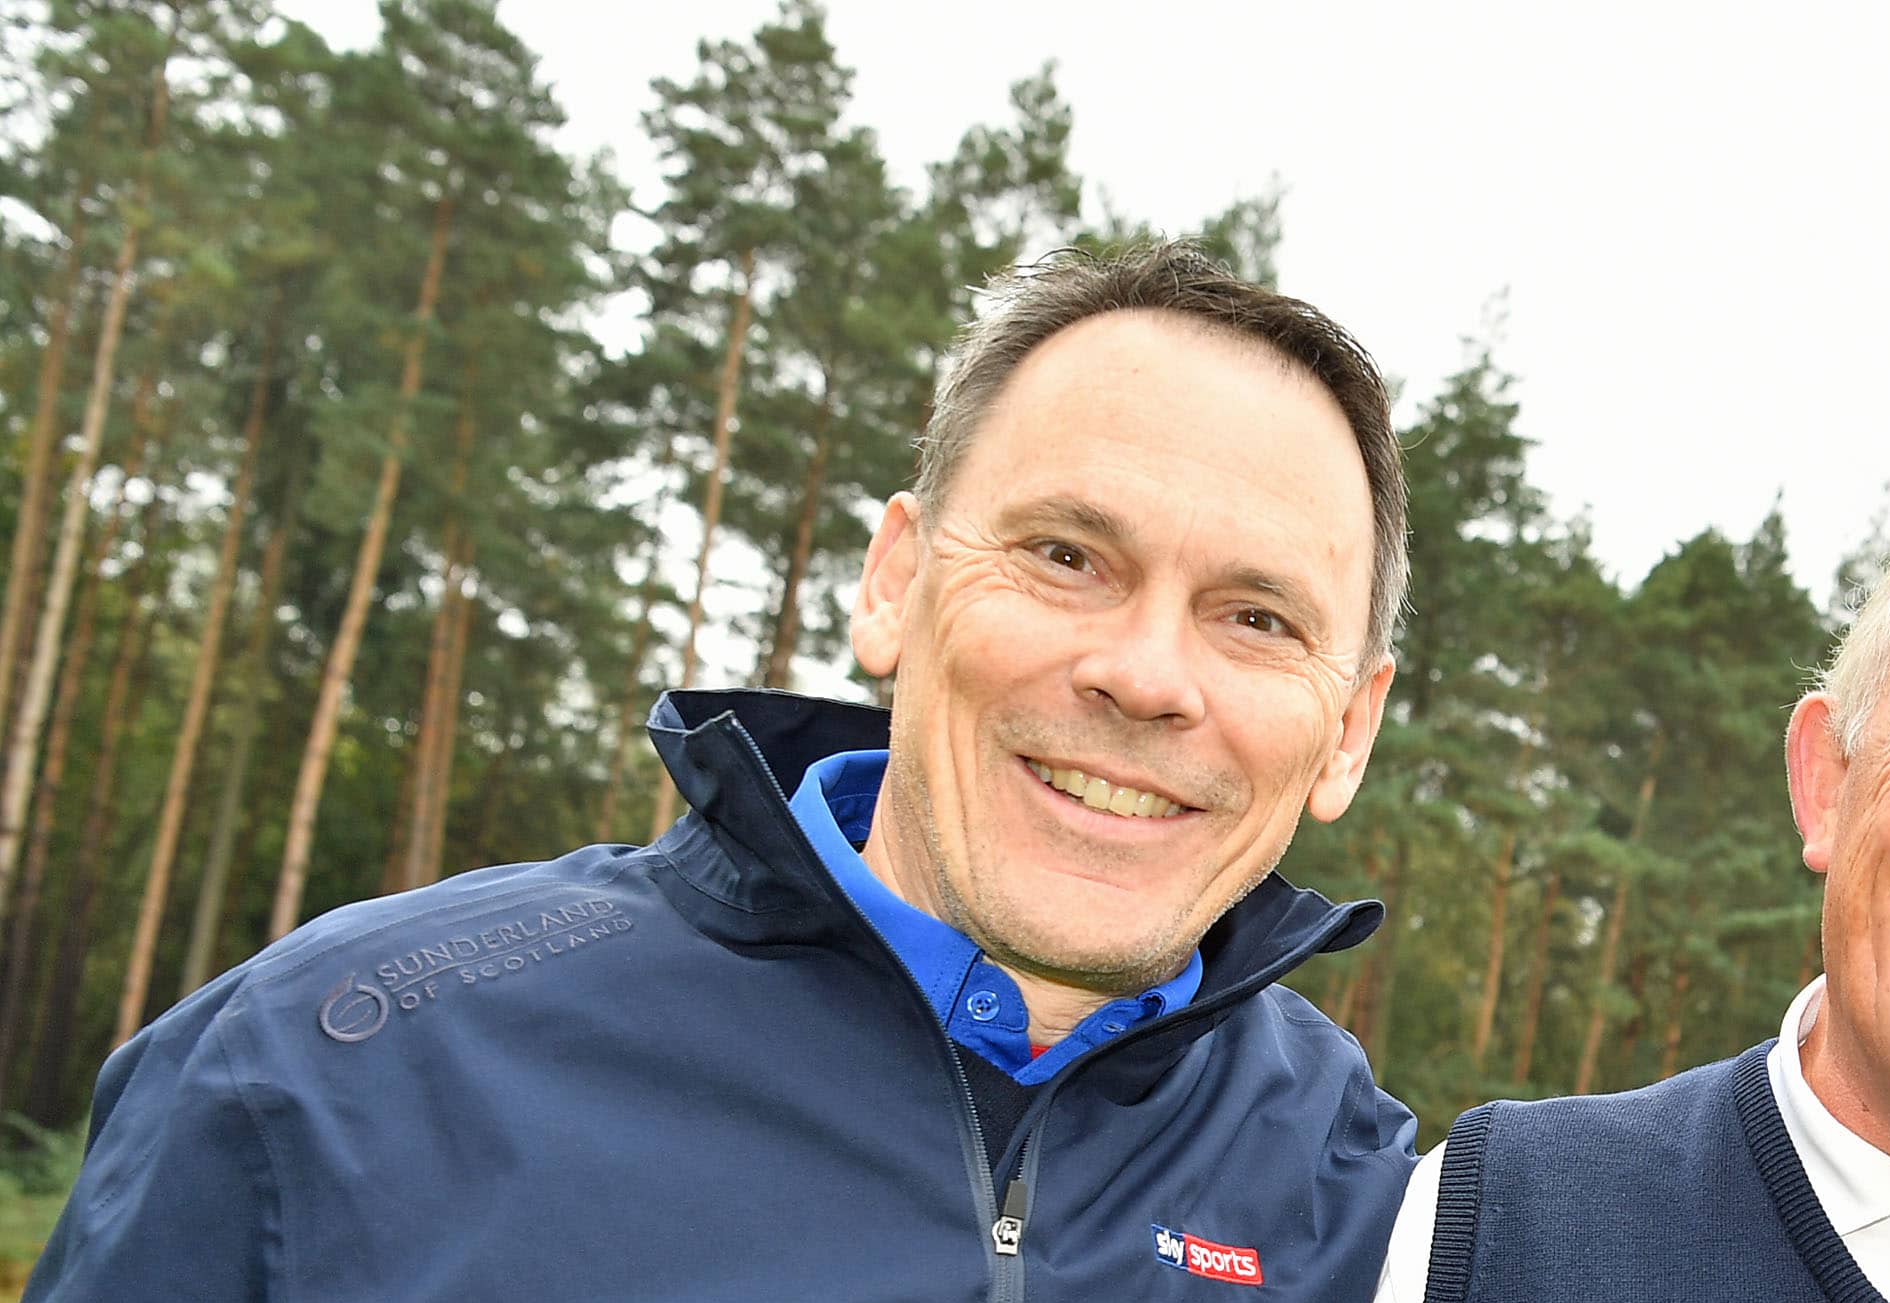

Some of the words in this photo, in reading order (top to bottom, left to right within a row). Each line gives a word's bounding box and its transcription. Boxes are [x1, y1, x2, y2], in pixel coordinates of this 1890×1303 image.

[377, 897, 614, 987] SUNDERLAND
[399, 983, 438, 1011] OF
[460, 918, 633, 985] SCOTLAND
[1157, 1230, 1185, 1265] sky
[1189, 1243, 1257, 1276] sports
